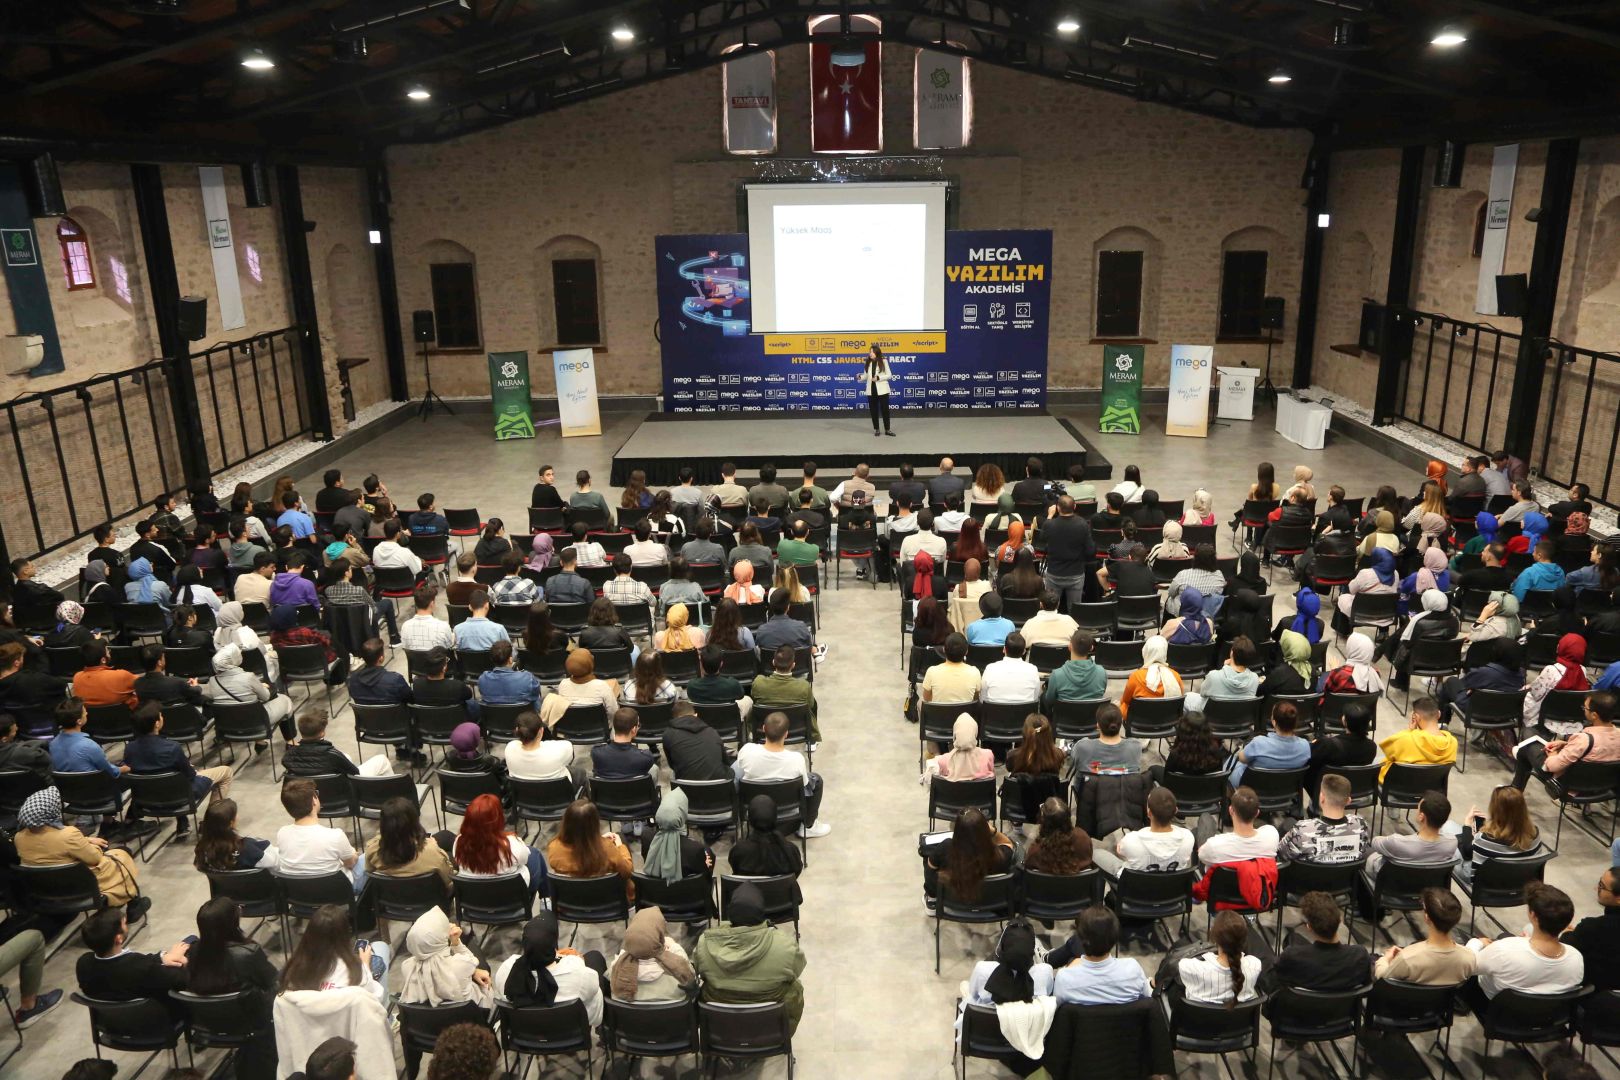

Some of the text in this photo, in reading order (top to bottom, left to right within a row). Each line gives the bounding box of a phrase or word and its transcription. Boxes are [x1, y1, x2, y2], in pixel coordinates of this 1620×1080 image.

[969, 248, 1022, 261] MEGA
[946, 264, 1044, 282] YAZILIM
[965, 282, 1024, 294] AKADEMİSİ
[840, 340, 866, 349] mega
[560, 361, 589, 372] mega
[1176, 358, 1207, 369] mega
[498, 379, 525, 387] MERAM
